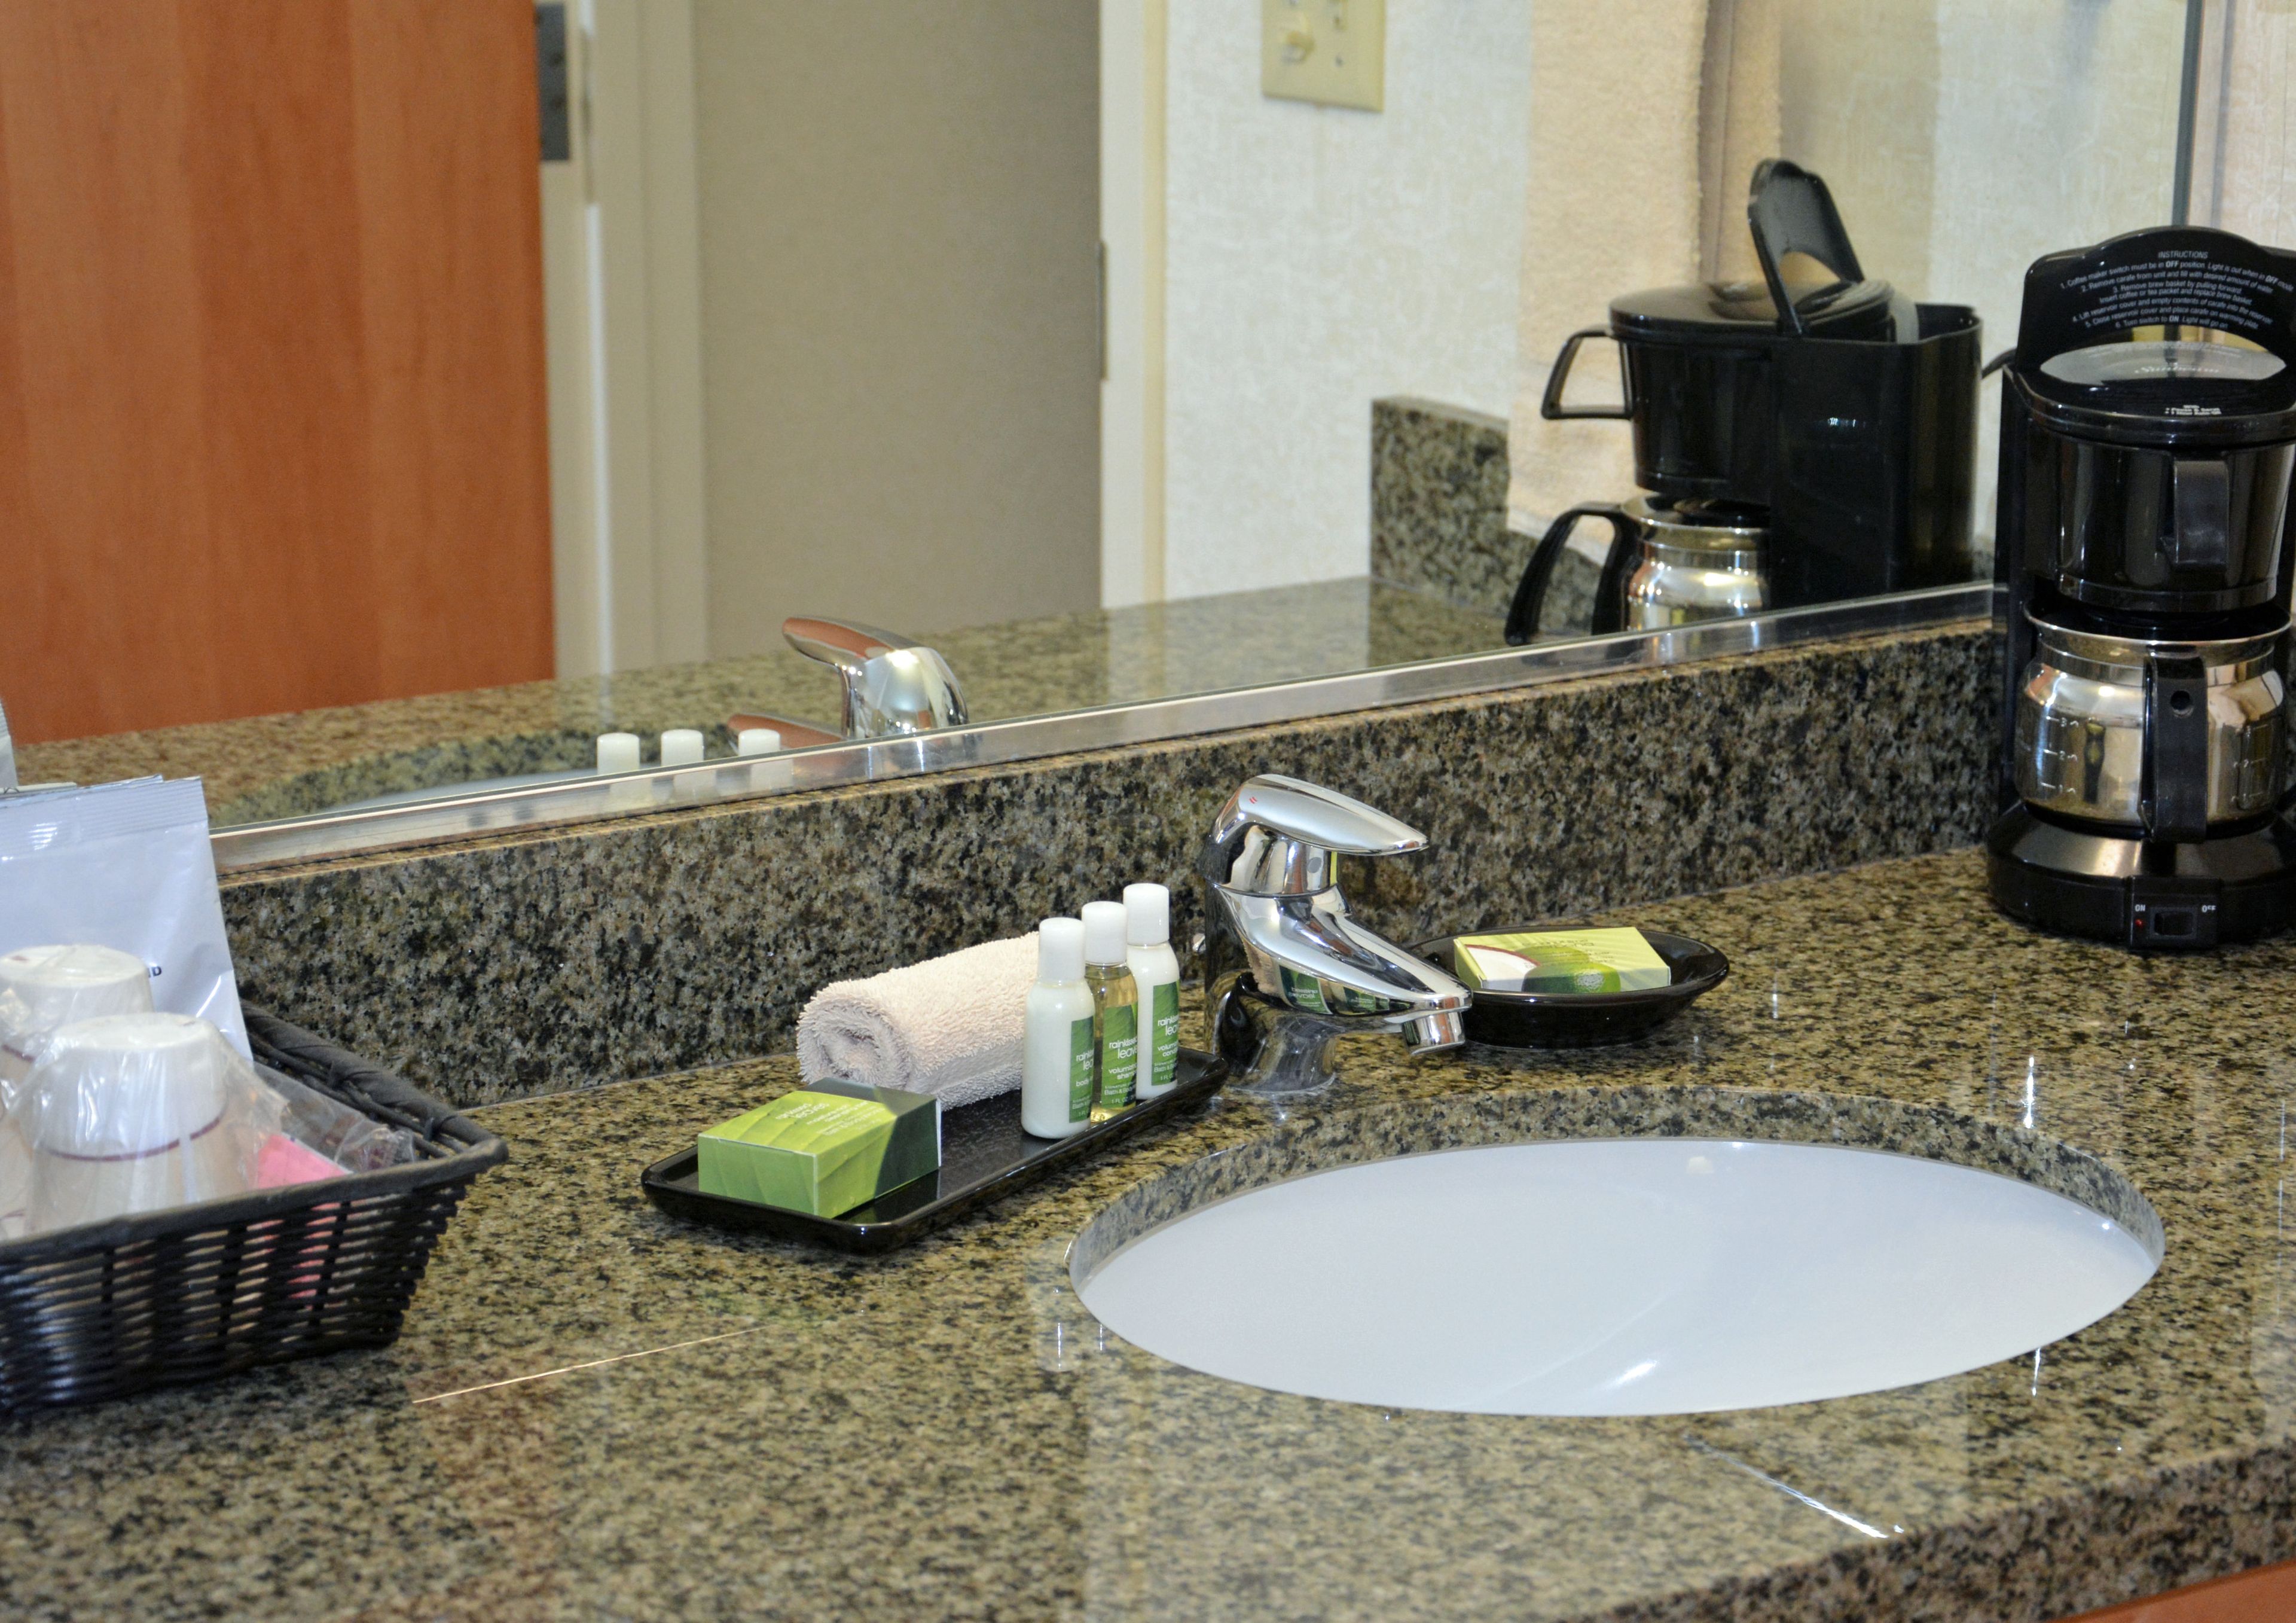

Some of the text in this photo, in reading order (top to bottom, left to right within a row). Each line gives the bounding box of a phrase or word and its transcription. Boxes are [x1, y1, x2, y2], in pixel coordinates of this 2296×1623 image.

[2158, 251, 2209, 259] INSTRUCTIONS
[2067, 276, 2087, 287] Coffee
[2088, 270, 2108, 280] maker
[2109, 266, 2130, 275] switch
[2208, 262, 2224, 271] Light
[2242, 269, 2259, 279] when
[2265, 275, 2279, 284] OFF
[2089, 278, 2115, 289] Remove
[2116, 274, 2135, 283] carafe
[2203, 272, 2227, 281] desired
[2226, 276, 2251, 286] amount
[2121, 282, 2147, 291] Remove
[2196, 281, 2218, 291] pulling
[2099, 294, 2117, 304] Insert
[2193, 289, 2216, 298] replace
[2216, 291, 2232, 300] brew
[2079, 311, 2091, 321] Lift
[2091, 303, 2117, 315] reservoir
[2119, 301, 2136, 309] cover
[2151, 297, 2171, 306] empty
[2208, 300, 2227, 309] carafe
[2227, 303, 2239, 312] into
[2239, 306, 2250, 315] the
[2093, 316, 2111, 325] Close
[2112, 309, 2139, 320] reservoir
[2172, 306, 2189, 315] place
[2190, 307, 2209, 316] carafe
[2219, 312, 2245, 325] warming
[2139, 316, 2160, 324] switch
[2182, 316, 2199, 325] Light
[1165, 1024, 1178, 1036] lea
[1083, 1058, 1094, 1071] lea
